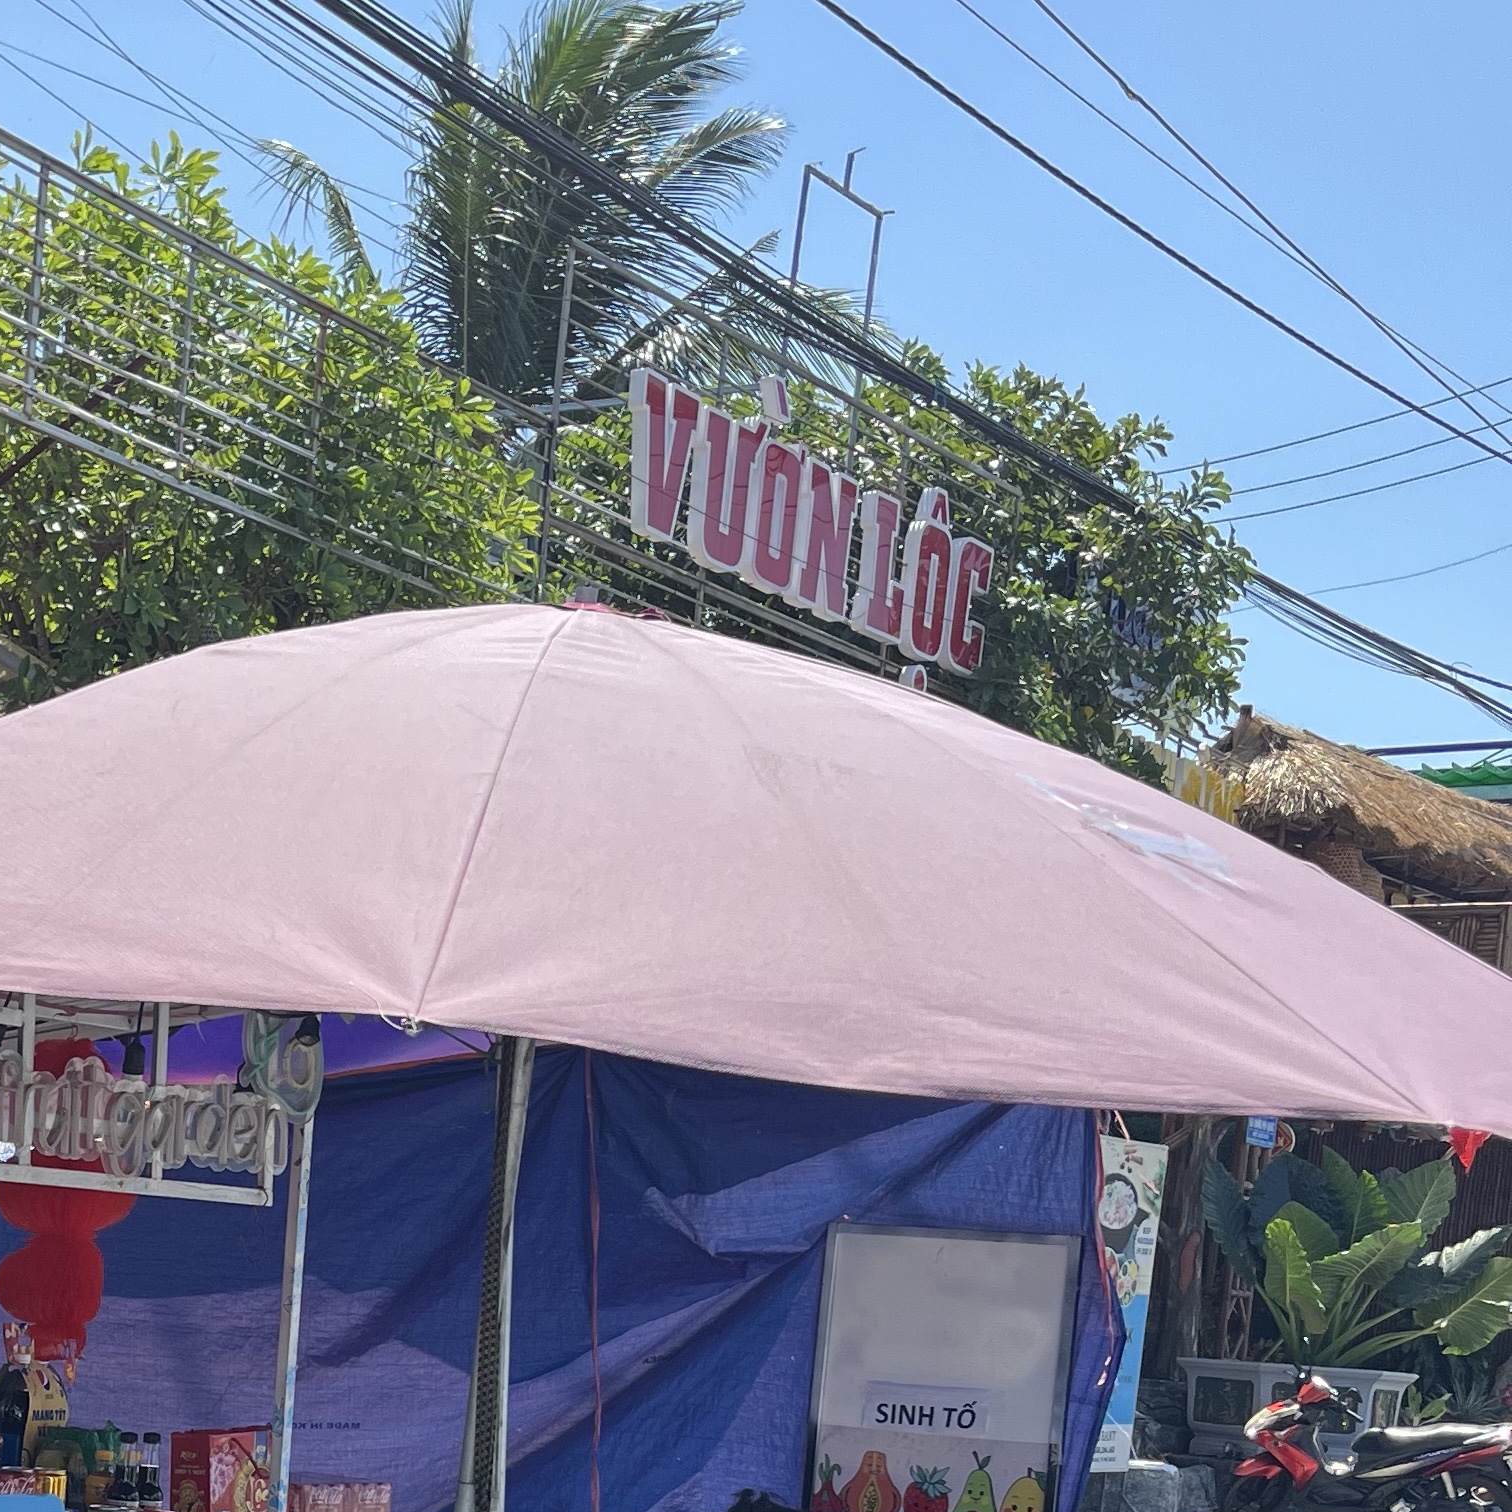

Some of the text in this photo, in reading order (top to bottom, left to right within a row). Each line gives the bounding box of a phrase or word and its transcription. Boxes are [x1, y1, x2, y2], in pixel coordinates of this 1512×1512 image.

[628, 366, 995, 692] VƯỜN LỘC
[875, 1400, 978, 1429] SINH TỐ
